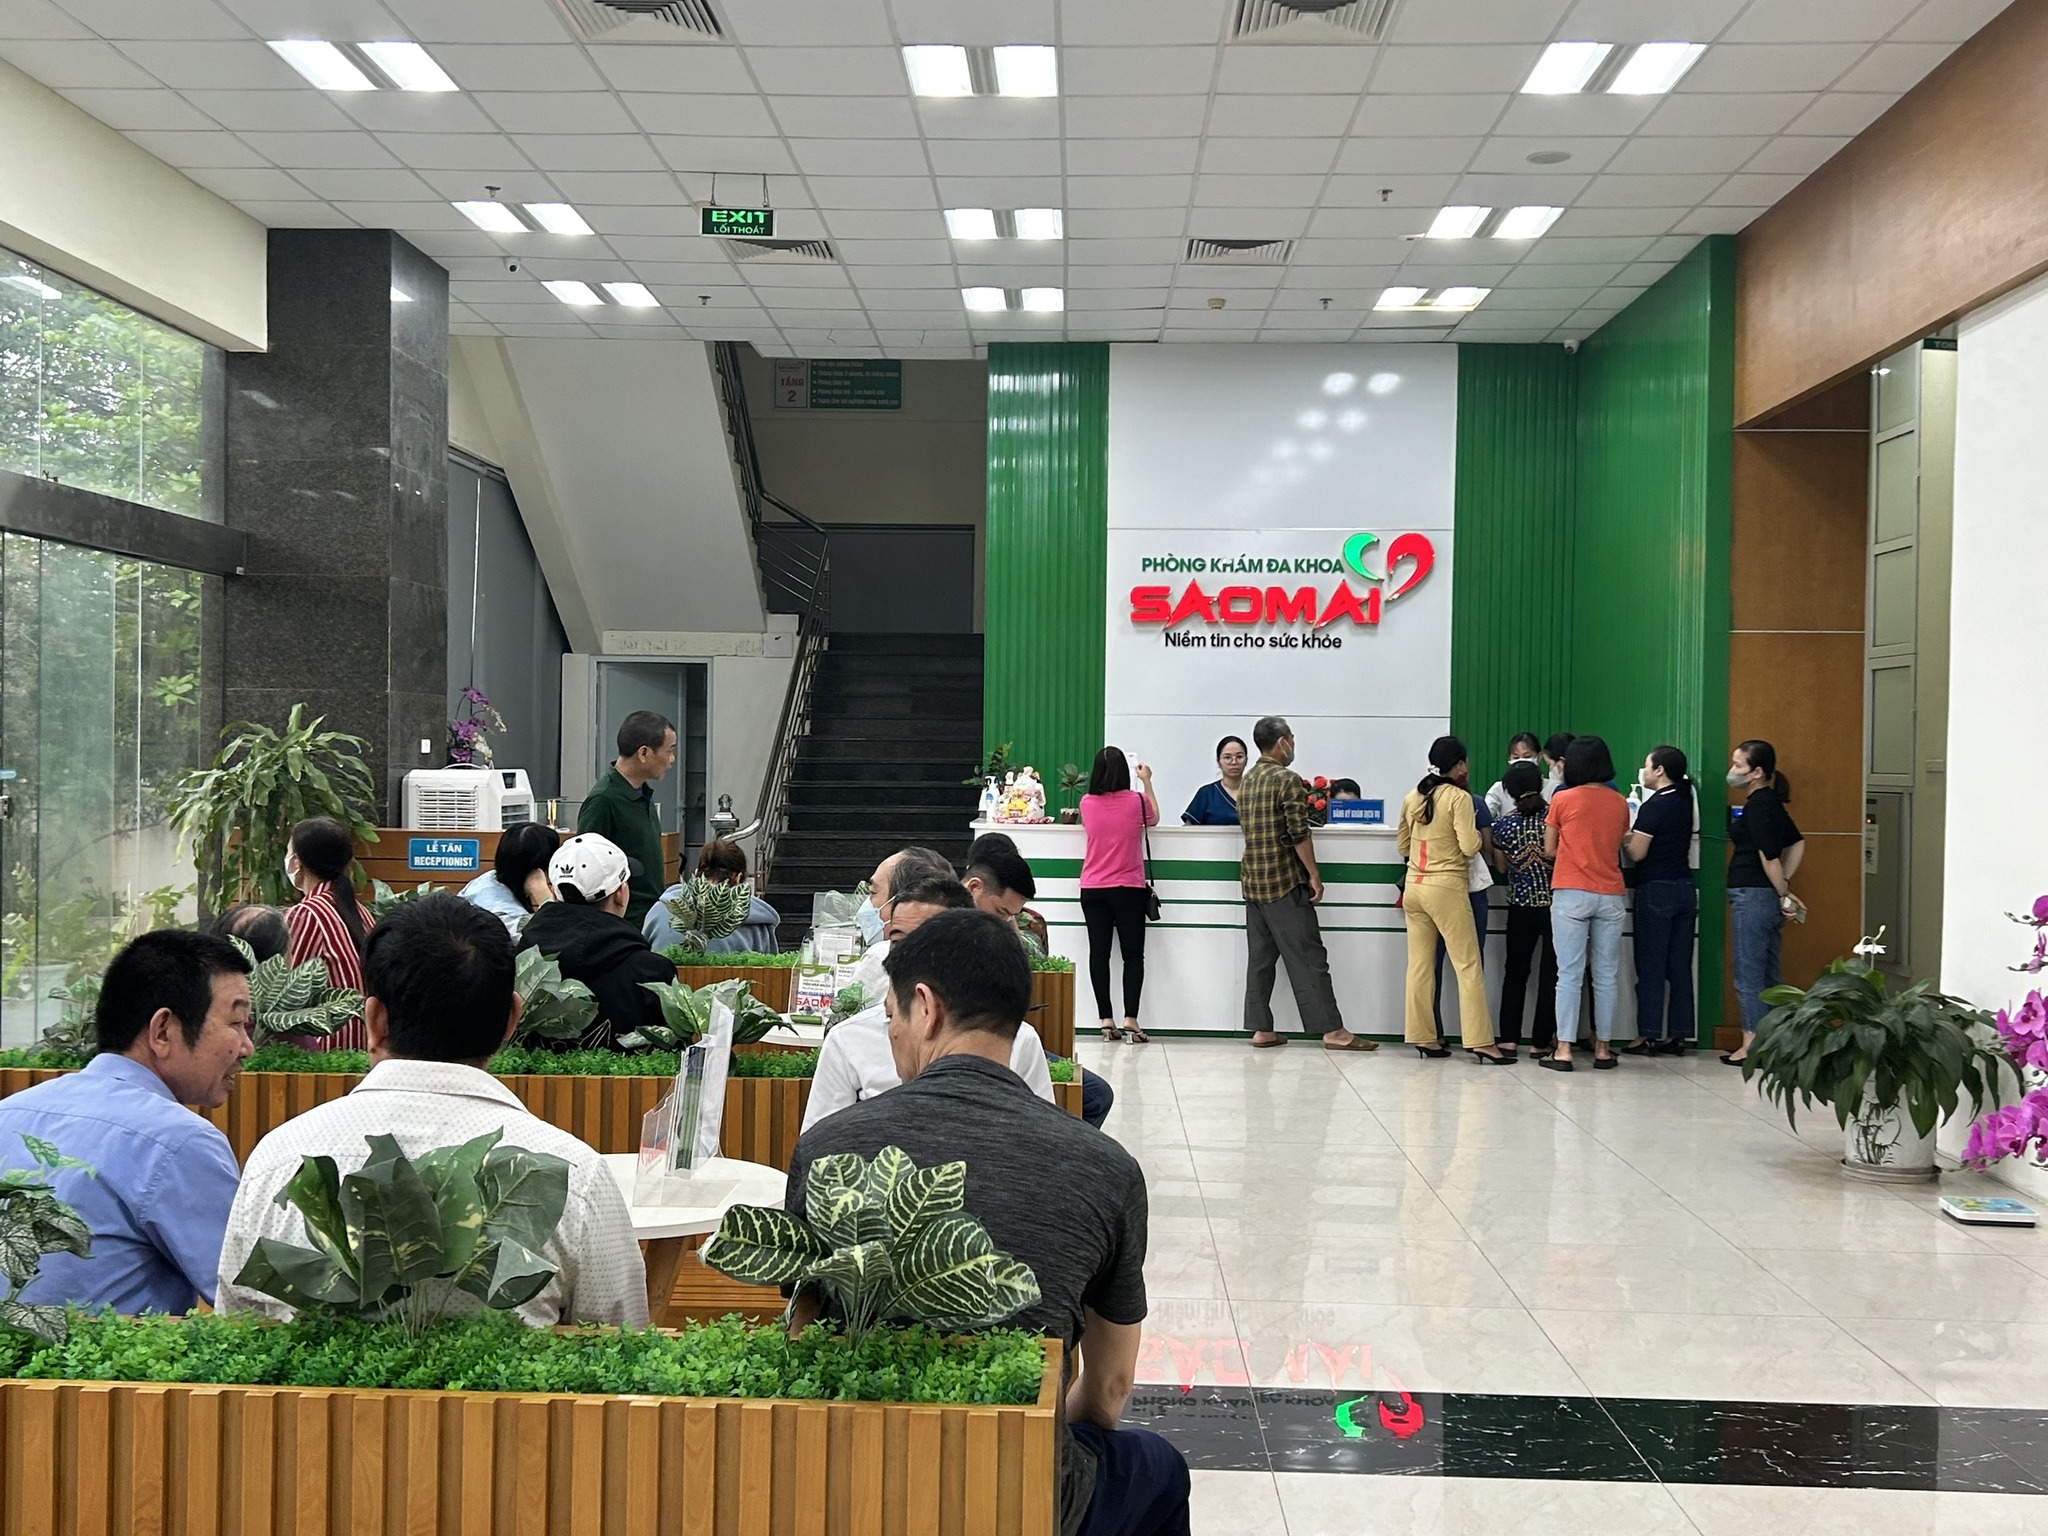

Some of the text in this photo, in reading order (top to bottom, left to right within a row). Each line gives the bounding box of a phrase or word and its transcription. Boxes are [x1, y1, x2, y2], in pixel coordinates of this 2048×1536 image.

[712, 210, 769, 223] EXIT
[732, 225, 765, 234] THOÁT
[788, 390, 797, 402] 2
[1142, 552, 1345, 574] PHÒNG KHÁM ĐA KHOA
[1210, 632, 1231, 648] tin
[1233, 632, 1265, 648] cho
[1269, 632, 1299, 649] sức
[1302, 633, 1343, 649] khỏe
[440, 843, 462, 853] TÂN
[414, 856, 474, 867] RECEPTIONIST
